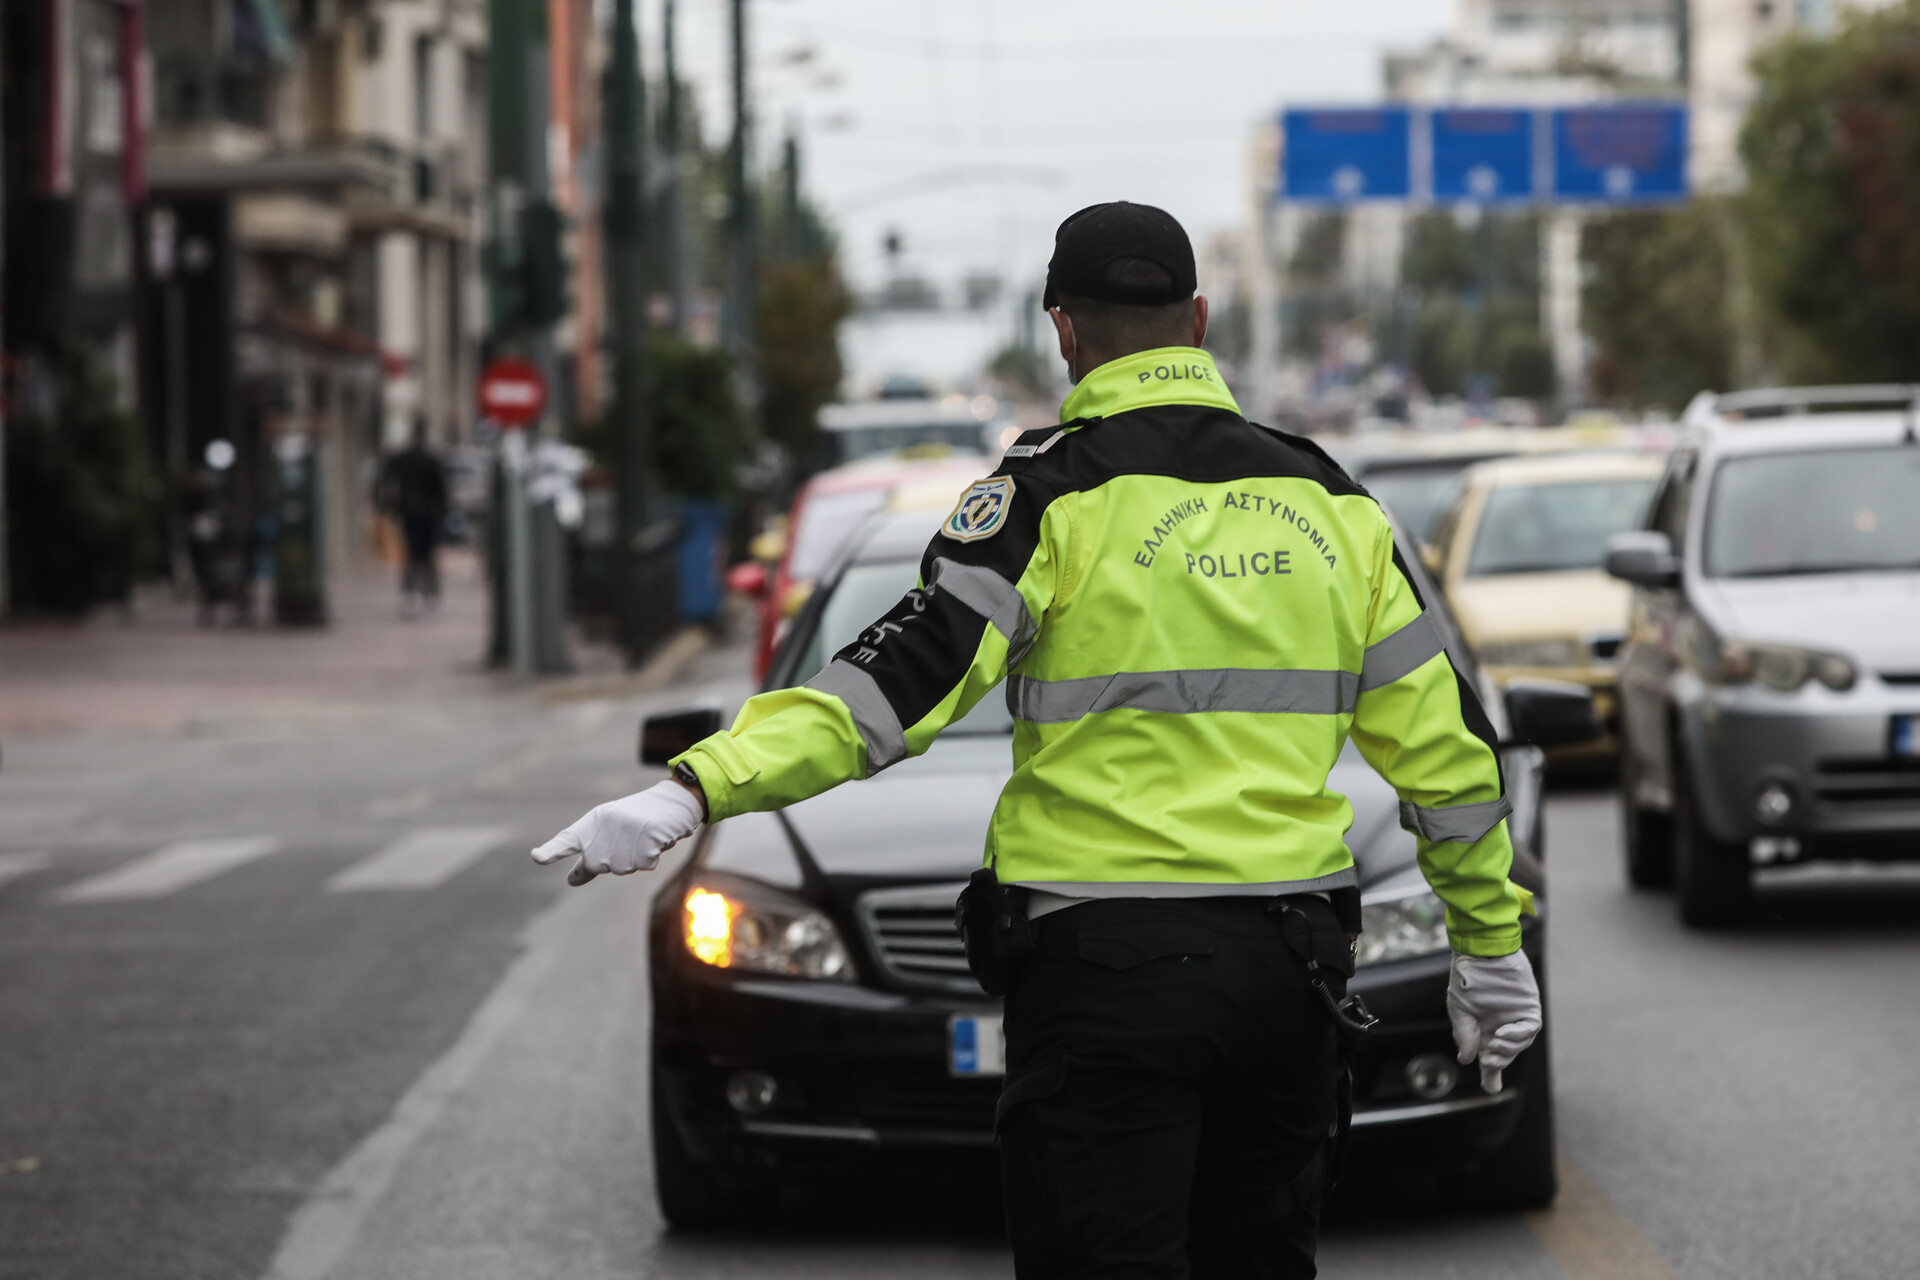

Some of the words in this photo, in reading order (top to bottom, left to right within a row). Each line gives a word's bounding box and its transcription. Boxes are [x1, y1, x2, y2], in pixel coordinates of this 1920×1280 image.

[1138, 364, 1213, 383] POLICE
[1134, 497, 1208, 568] ΕΛΛΗΝΙΚΗ
[1224, 491, 1337, 570] ΑΣΤΥΝΟΜΙΑ
[1185, 550, 1292, 578] POLICE
